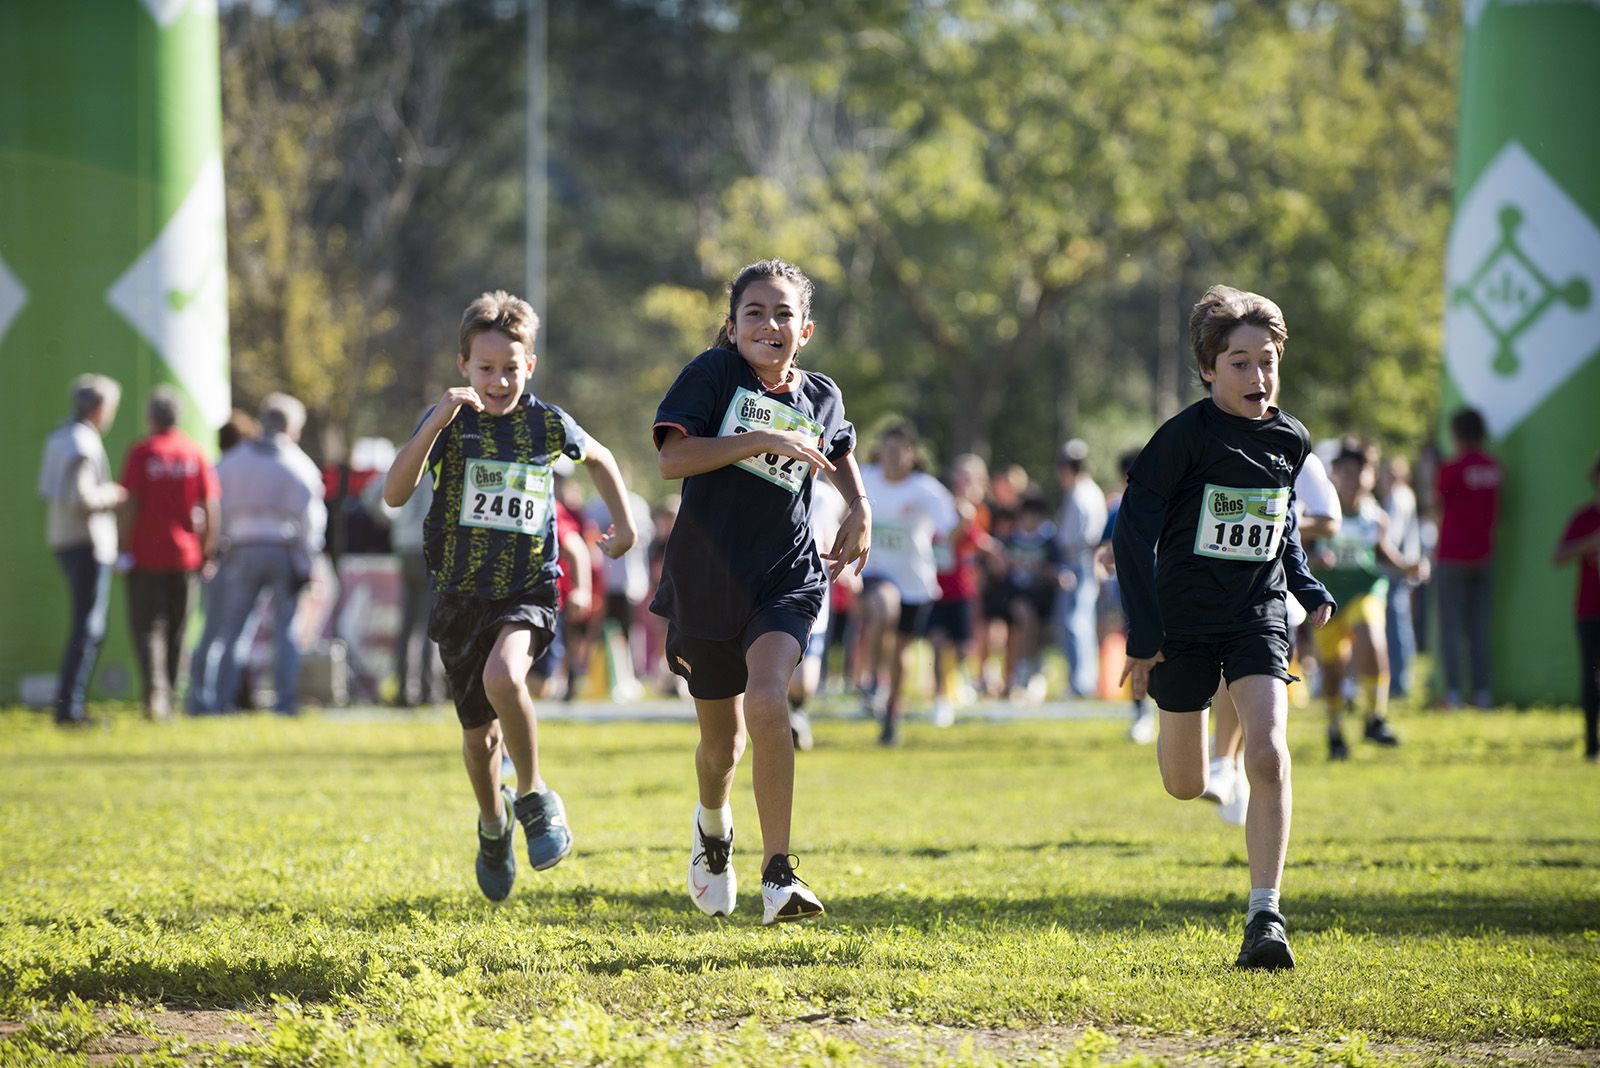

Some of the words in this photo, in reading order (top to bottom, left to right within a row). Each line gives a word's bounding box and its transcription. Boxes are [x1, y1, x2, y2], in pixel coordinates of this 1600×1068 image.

[741, 406, 771, 421] CROS
[476, 471, 503, 484] CROS
[473, 493, 534, 520] 2468
[1214, 499, 1244, 512] CROS
[1214, 523, 1275, 547] 1887
